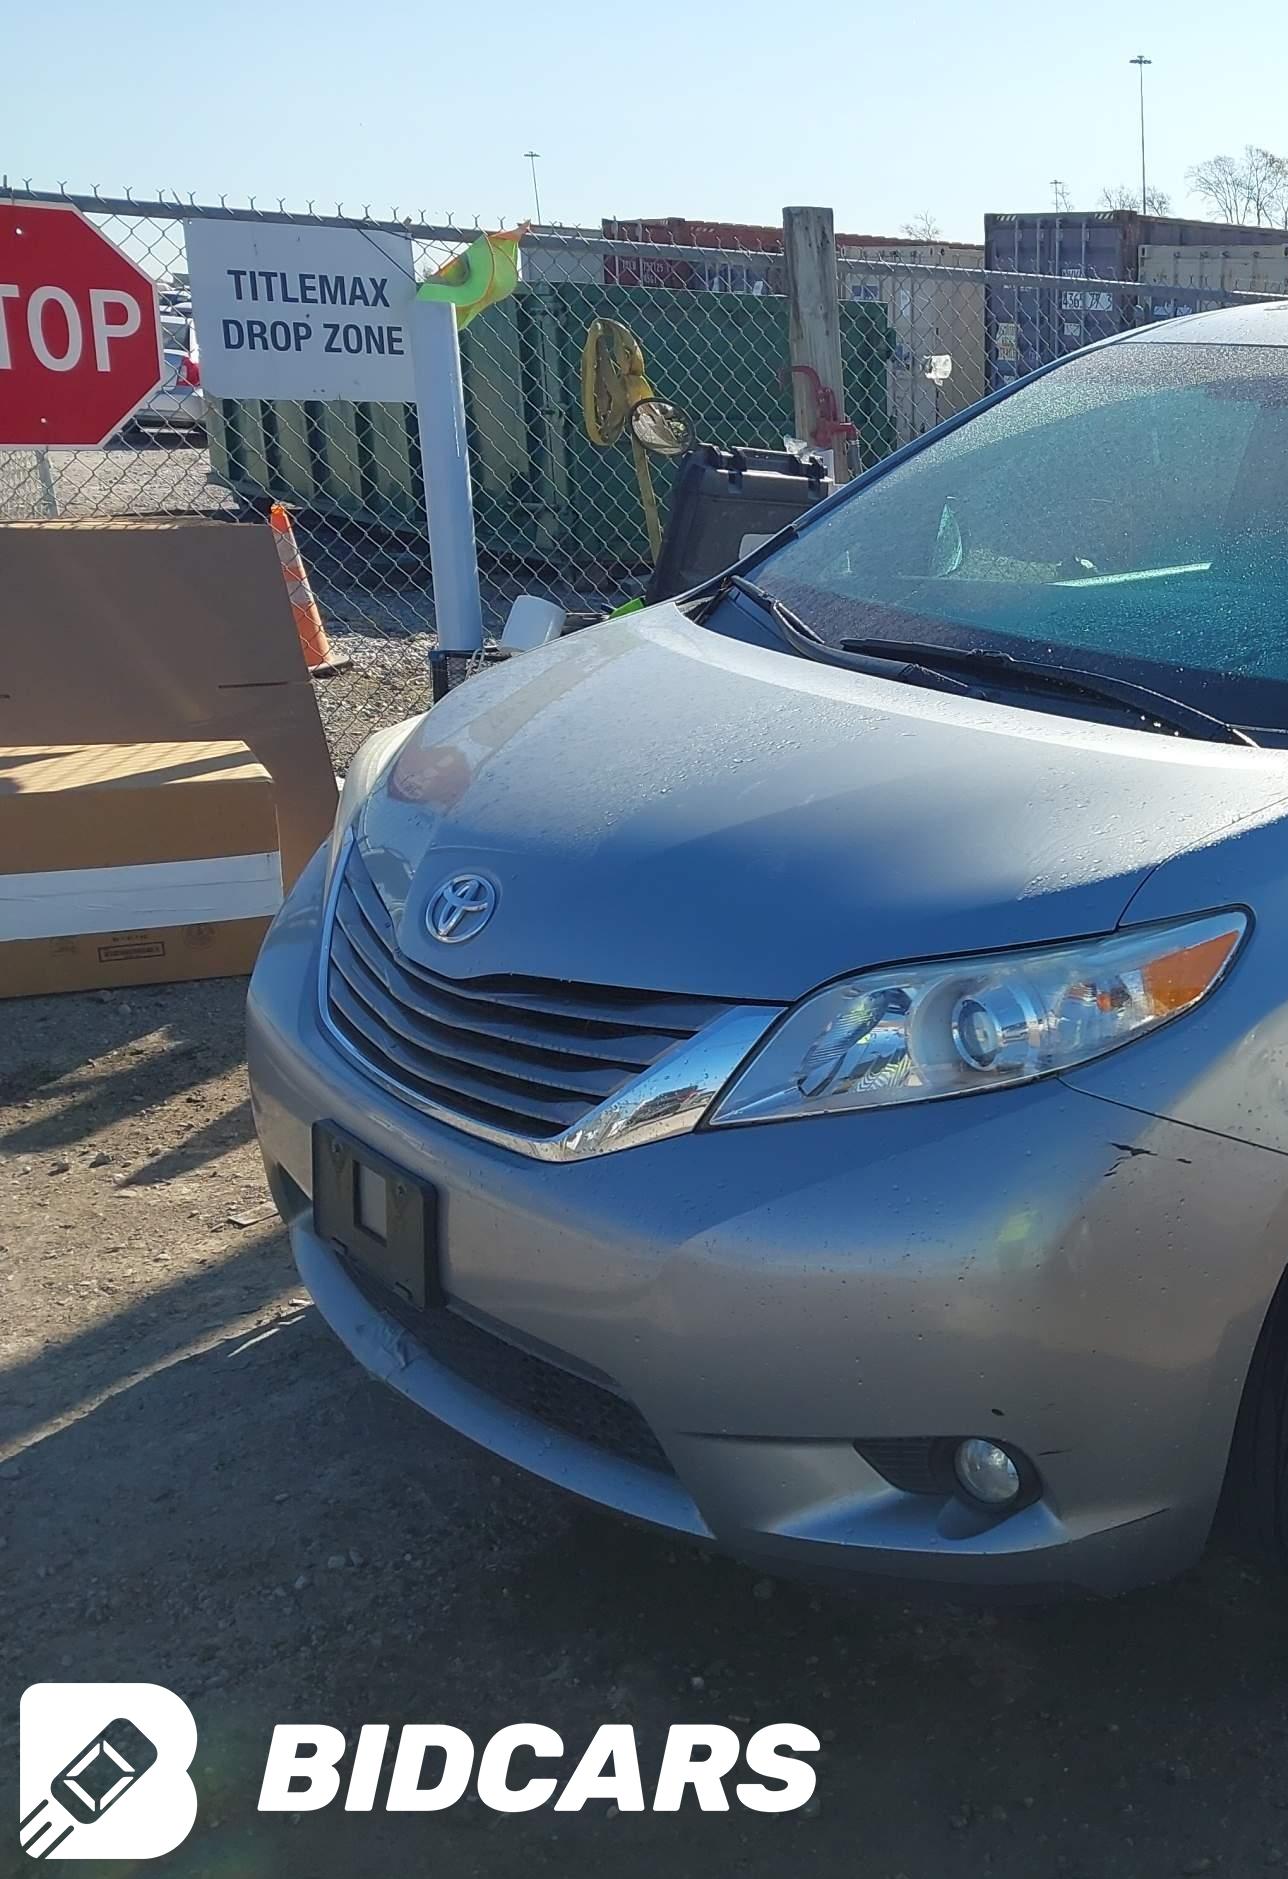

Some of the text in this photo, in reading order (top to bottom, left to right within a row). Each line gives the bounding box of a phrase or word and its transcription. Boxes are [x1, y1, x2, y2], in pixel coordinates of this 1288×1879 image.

[227, 269, 390, 307] TITLEMAX
[222, 319, 404, 355] DROP ZONE
